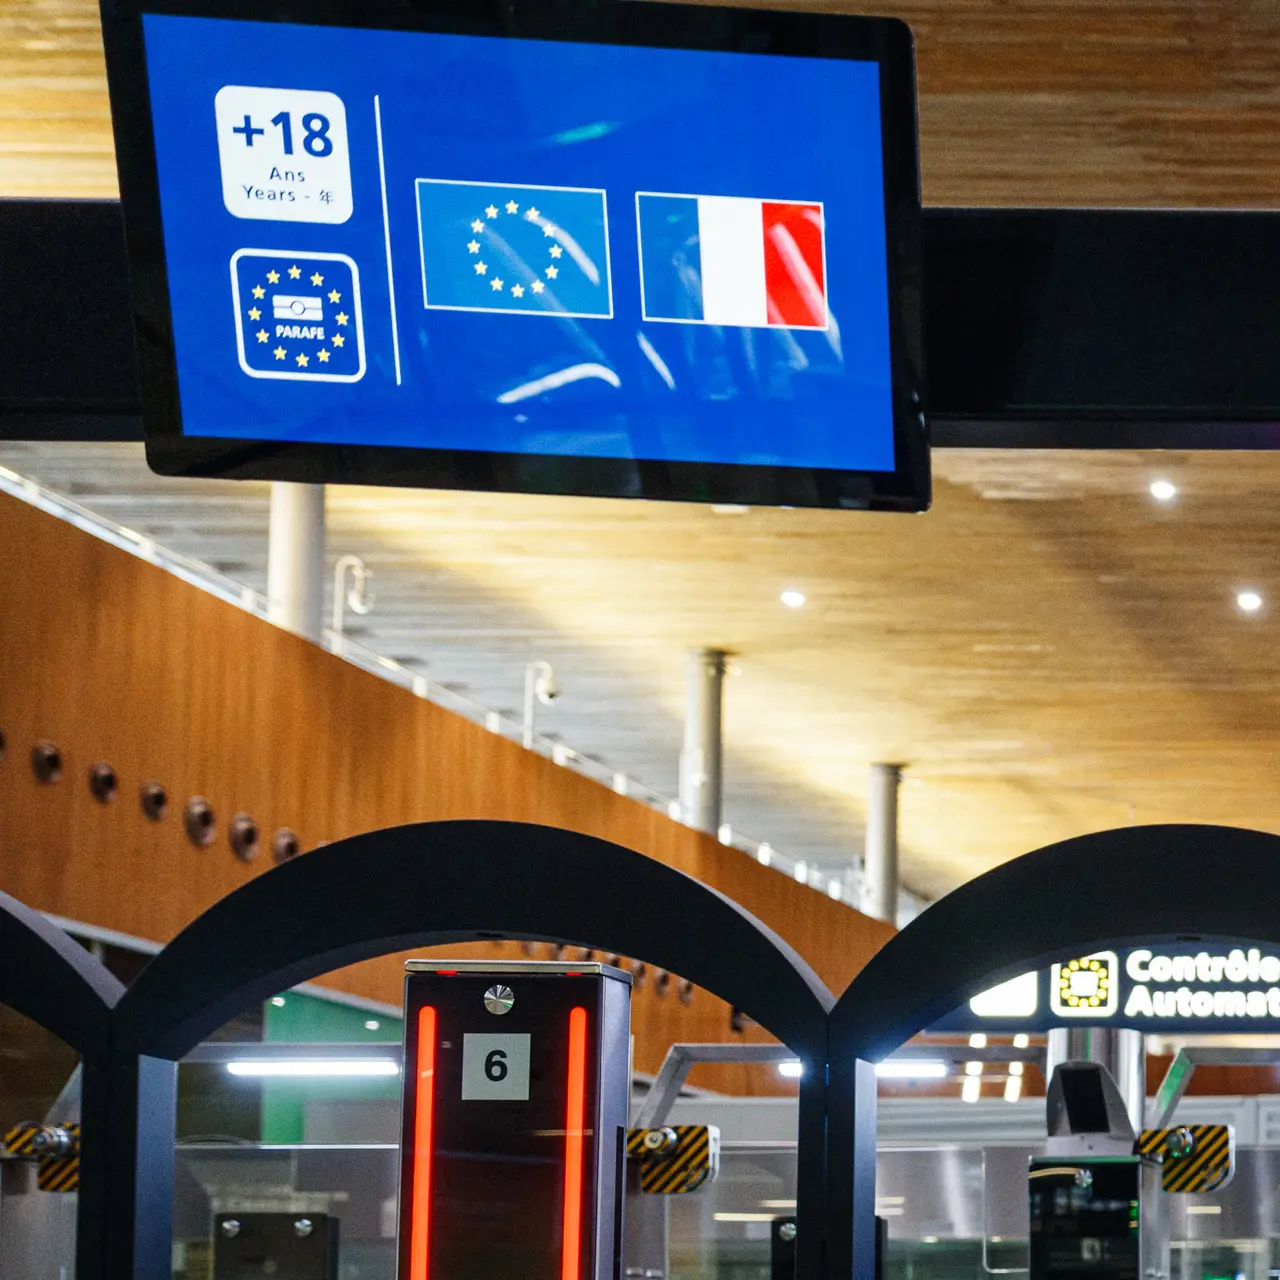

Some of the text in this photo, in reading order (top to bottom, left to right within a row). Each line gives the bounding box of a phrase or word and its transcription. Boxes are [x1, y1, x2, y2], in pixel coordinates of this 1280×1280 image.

[233, 111, 333, 158] +18
[269, 167, 306, 183] Ans
[242, 185, 296, 202] Years
[319, 189, 334, 205] 年
[275, 324, 325, 340] PARAFE
[484, 1049, 508, 1083] 6
